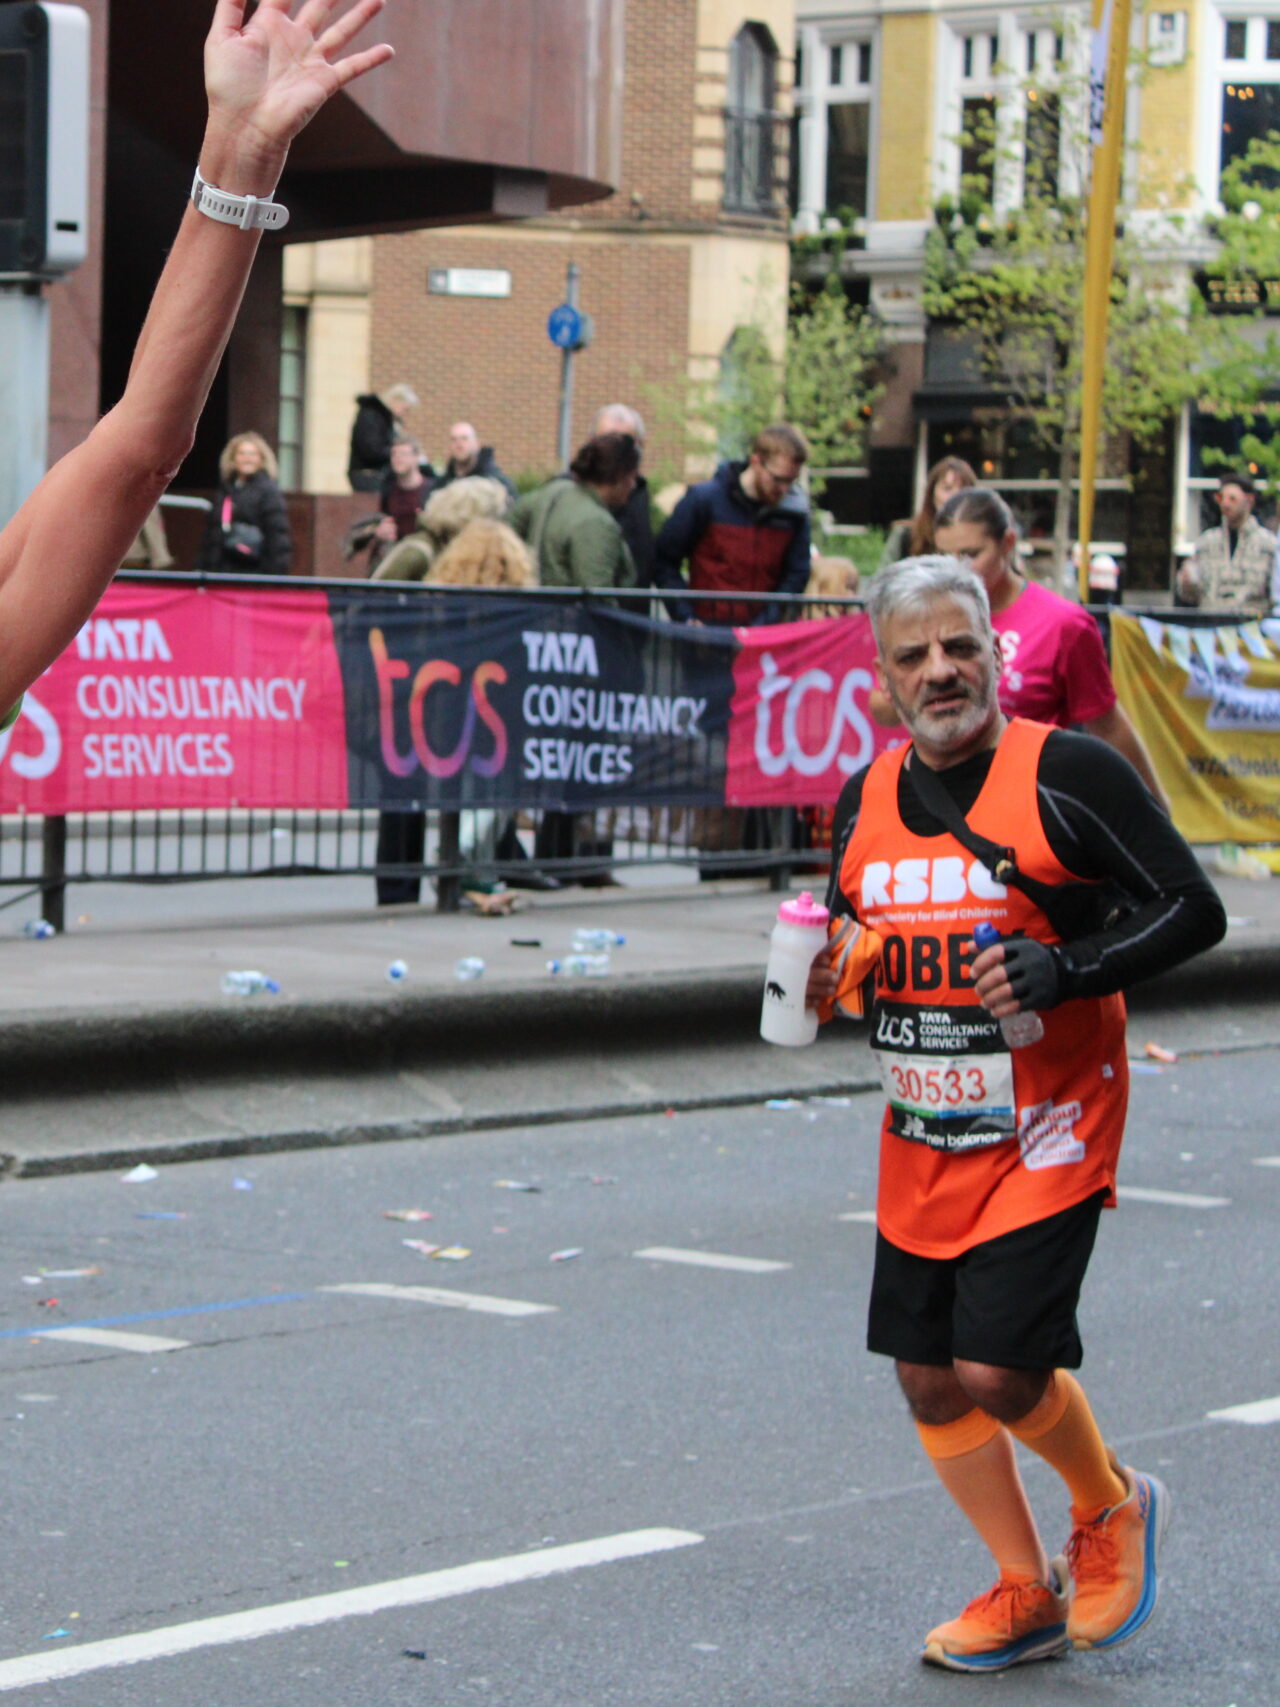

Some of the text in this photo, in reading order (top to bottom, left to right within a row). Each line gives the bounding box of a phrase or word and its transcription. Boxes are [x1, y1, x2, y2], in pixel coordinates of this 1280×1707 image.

[75, 618, 173, 661] TATA
[522, 631, 600, 677] TATA
[76, 675, 306, 720] CONSULTANCY
[369, 628, 508, 778] tcs
[754, 652, 874, 777] tcs
[82, 733, 234, 778] SERVICES
[958, 906, 1008, 920] Children
[877, 1008, 915, 1047] tcs
[919, 1012, 951, 1024] TATA
[920, 1024, 998, 1037] CONSULTANCY
[920, 1037, 969, 1049] SERVICES
[891, 1065, 986, 1104] 30533
[947, 1132, 1002, 1147] balance
